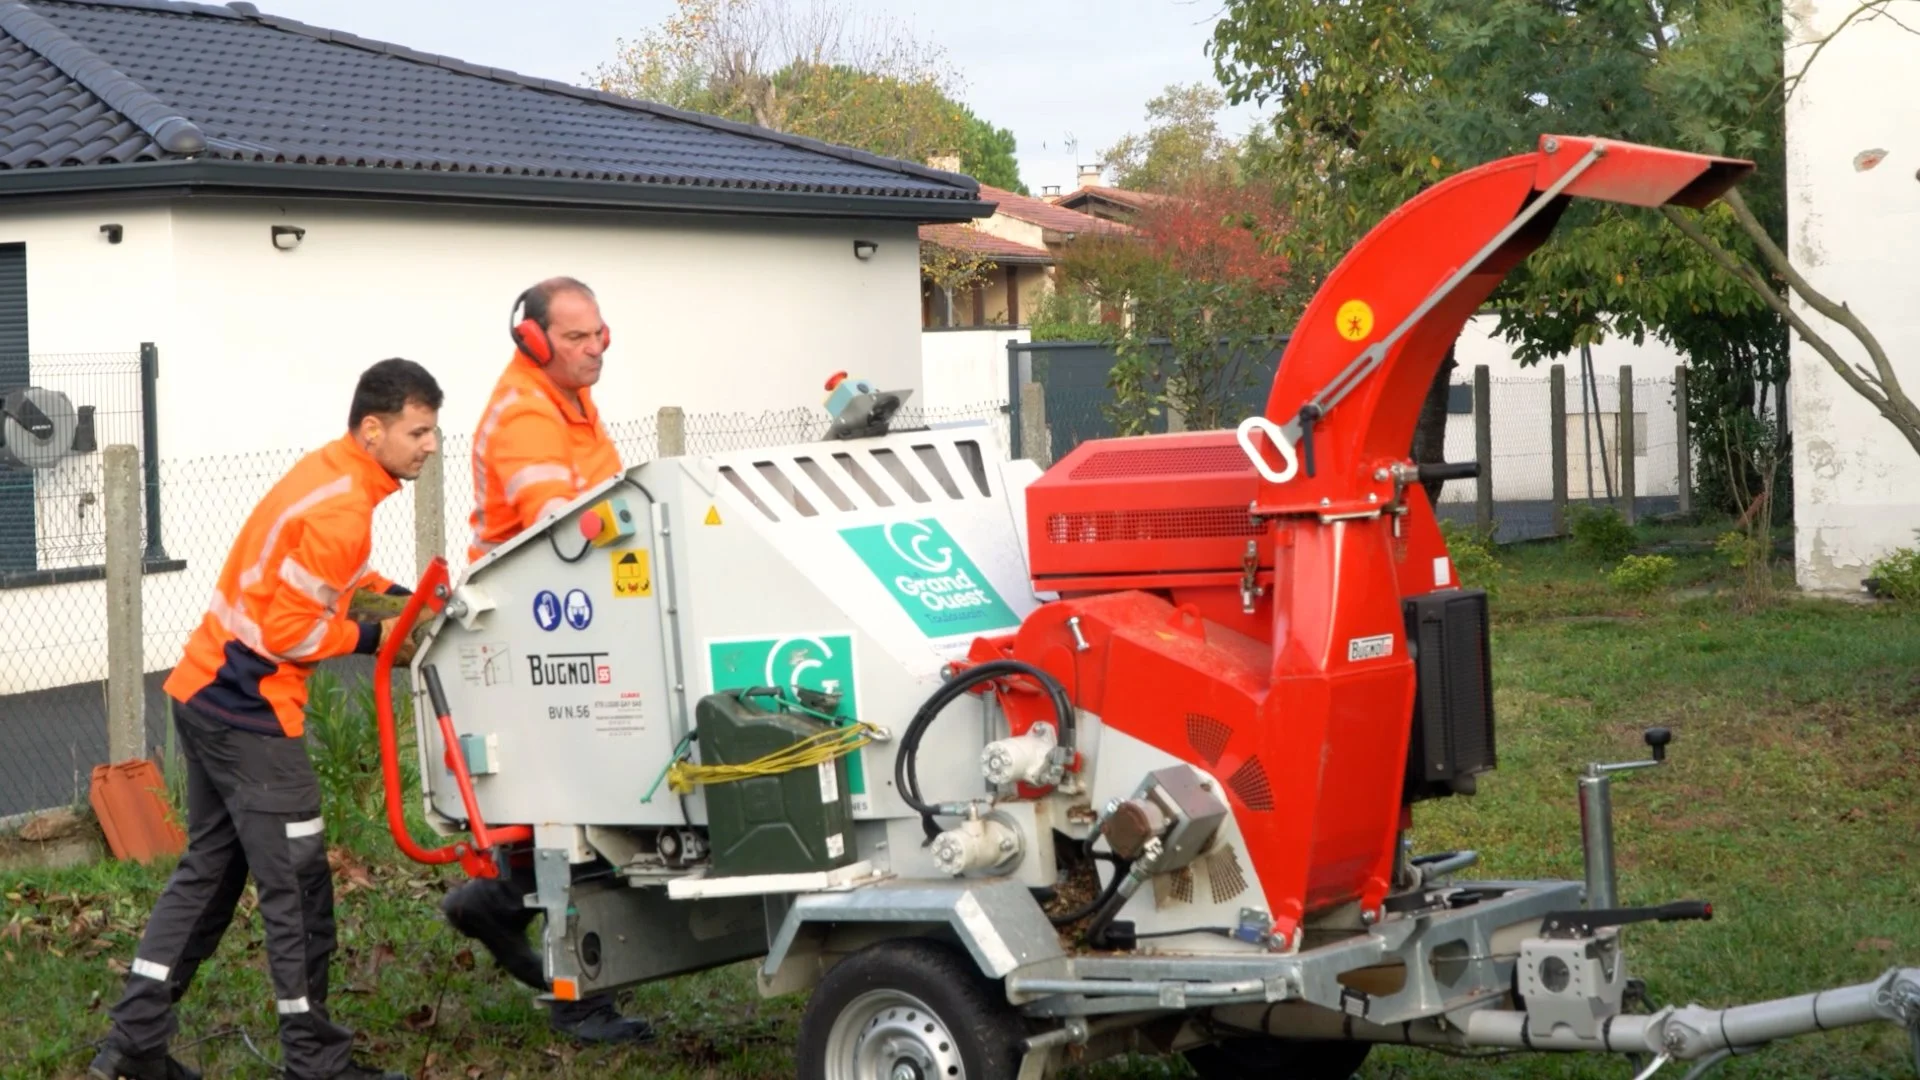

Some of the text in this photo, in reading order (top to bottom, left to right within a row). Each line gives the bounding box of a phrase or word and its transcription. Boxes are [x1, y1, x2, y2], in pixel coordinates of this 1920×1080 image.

[895, 568, 977, 596] Grand
[920, 589, 992, 611] Ouest
[526, 652, 609, 685] BUGNOT
